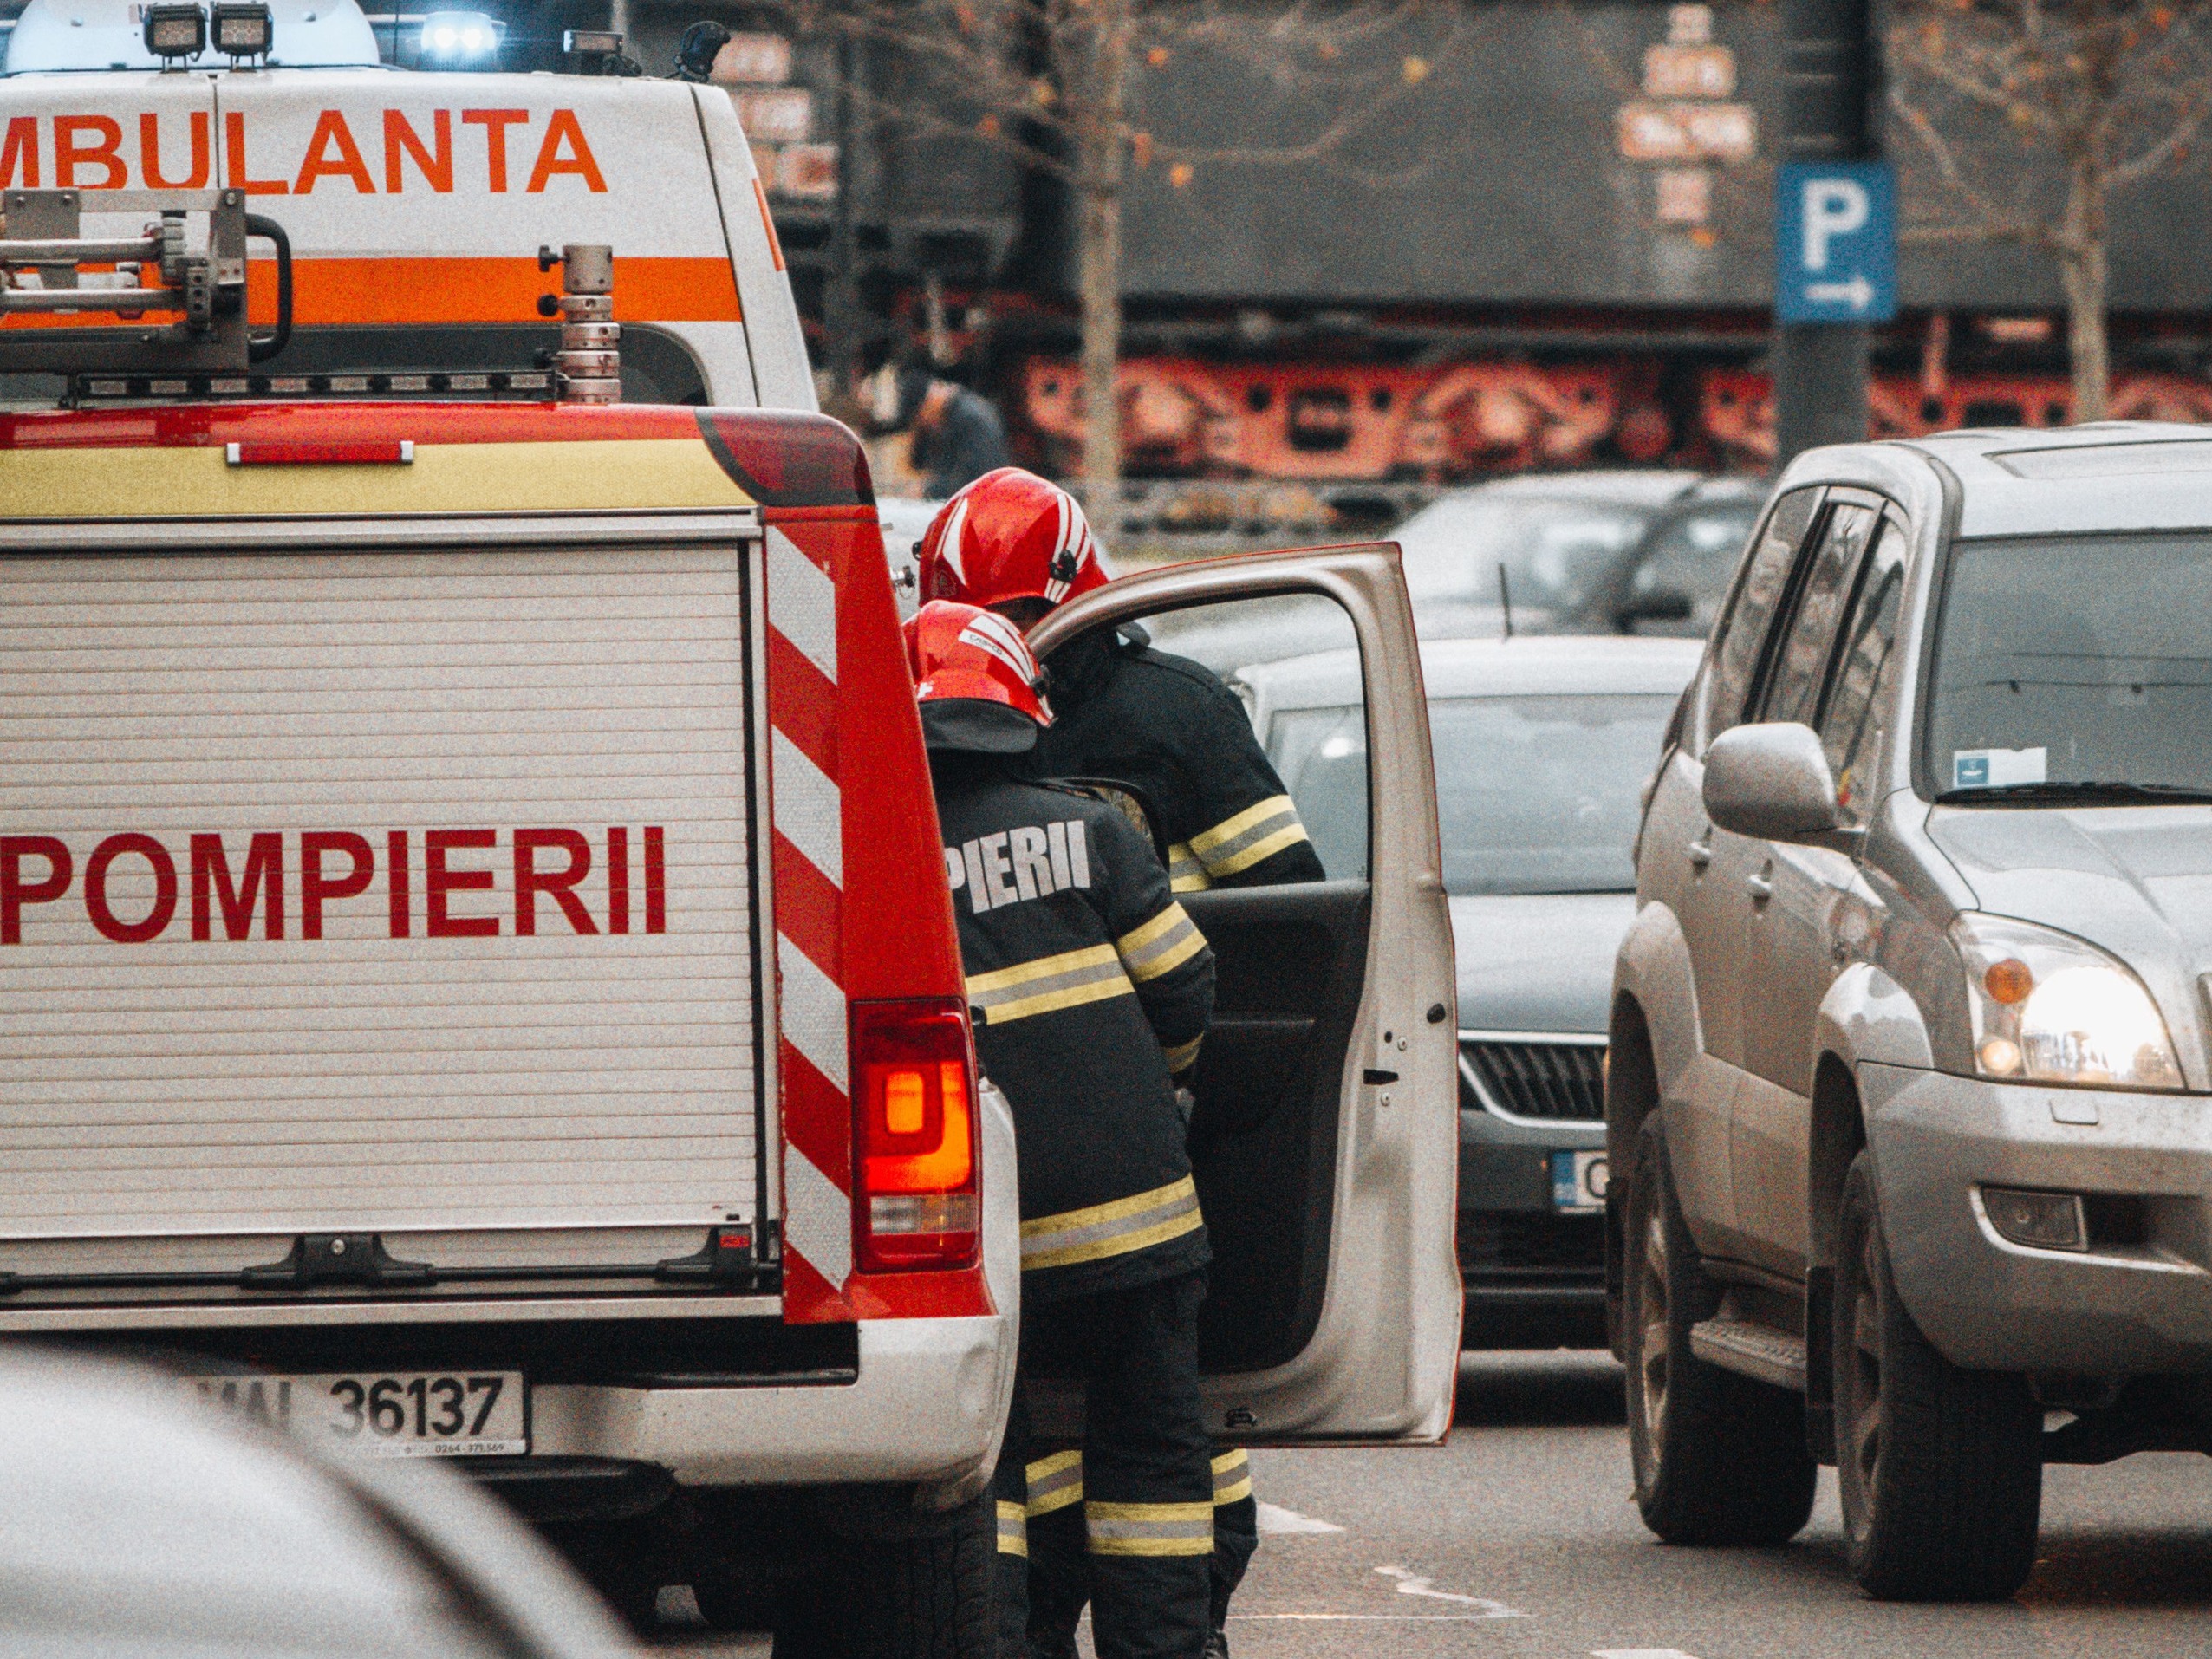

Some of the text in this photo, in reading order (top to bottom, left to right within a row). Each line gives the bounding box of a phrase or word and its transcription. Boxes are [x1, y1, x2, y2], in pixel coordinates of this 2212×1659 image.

[1802, 179, 1870, 270] P
[0, 826, 666, 946] POMPIERII
[330, 1377, 504, 1439] 36137
